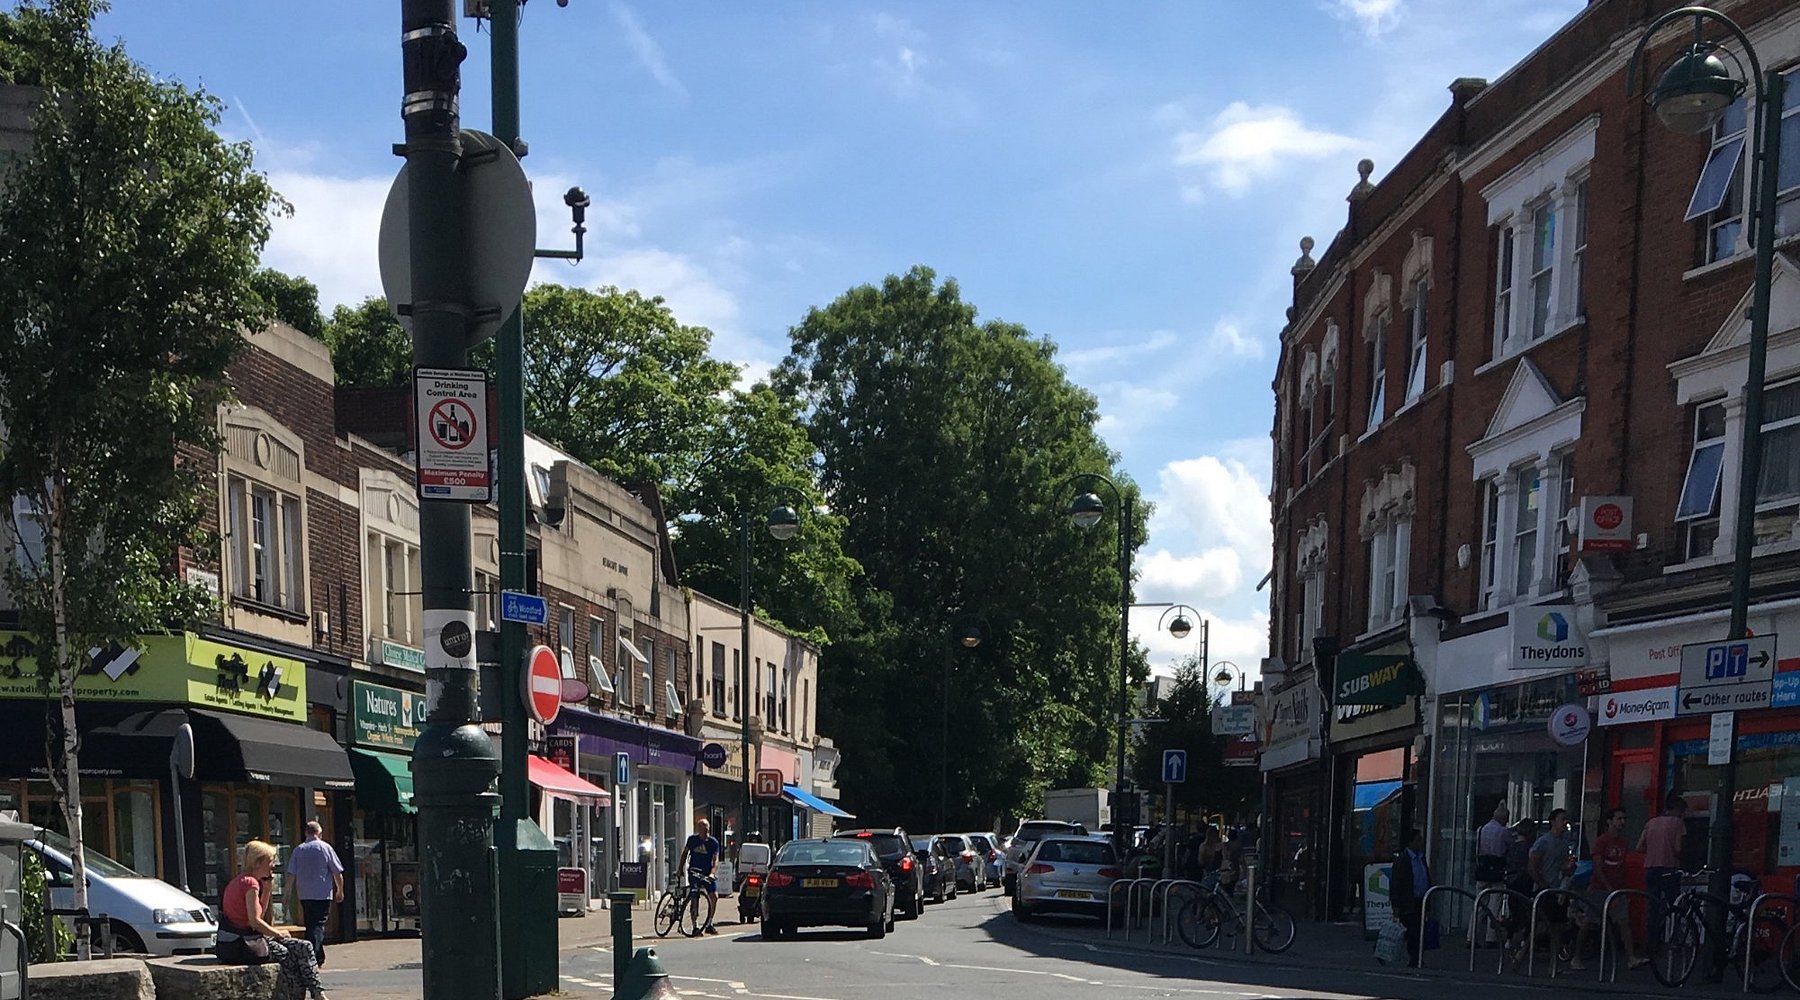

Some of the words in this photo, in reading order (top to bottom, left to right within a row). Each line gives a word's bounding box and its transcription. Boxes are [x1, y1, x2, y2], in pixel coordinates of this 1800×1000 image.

[434, 381, 468, 390] Drinking
[426, 389, 456, 397] Control
[424, 469, 458, 477] Maximum
[443, 477, 466, 485] £500
[1520, 645, 1584, 661] Theydons
[1649, 648, 1666, 660] Post
[1668, 645, 1681, 658] Off
[1339, 662, 1404, 698] SUBWAY
[1772, 676, 1800, 690] op-Up
[366, 690, 397, 717] Natures
[1703, 692, 1732, 706] Other
[1734, 690, 1767, 704] routes
[1776, 691, 1796, 702] Here
[1619, 700, 1670, 715] MoneyGram
[762, 774, 775, 792] in
[622, 864, 642, 873] haart
